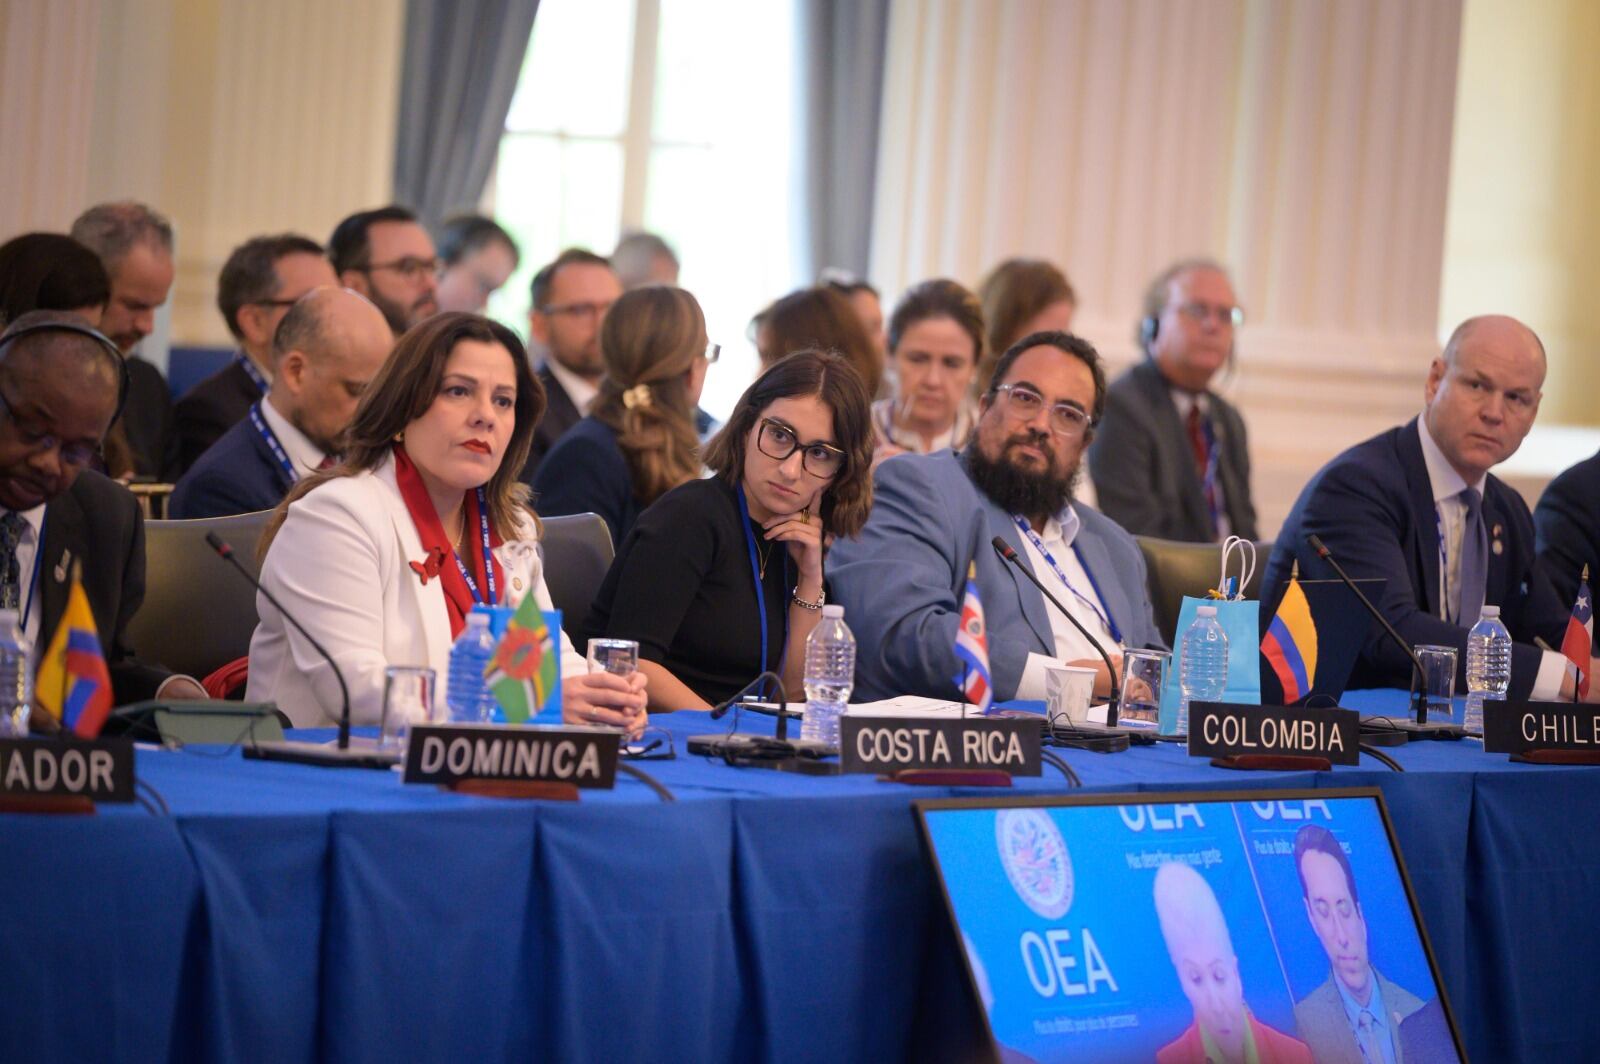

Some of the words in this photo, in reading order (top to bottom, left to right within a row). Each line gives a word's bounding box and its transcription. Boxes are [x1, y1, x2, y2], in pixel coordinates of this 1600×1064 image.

[856, 727, 951, 763] COSTA
[962, 729, 1026, 765] RICA
[1203, 713, 1344, 753] COLOMBIA
[4, 748, 115, 793] ADOR
[420, 735, 601, 780] DOMINICA
[1020, 927, 1120, 998] OEA
